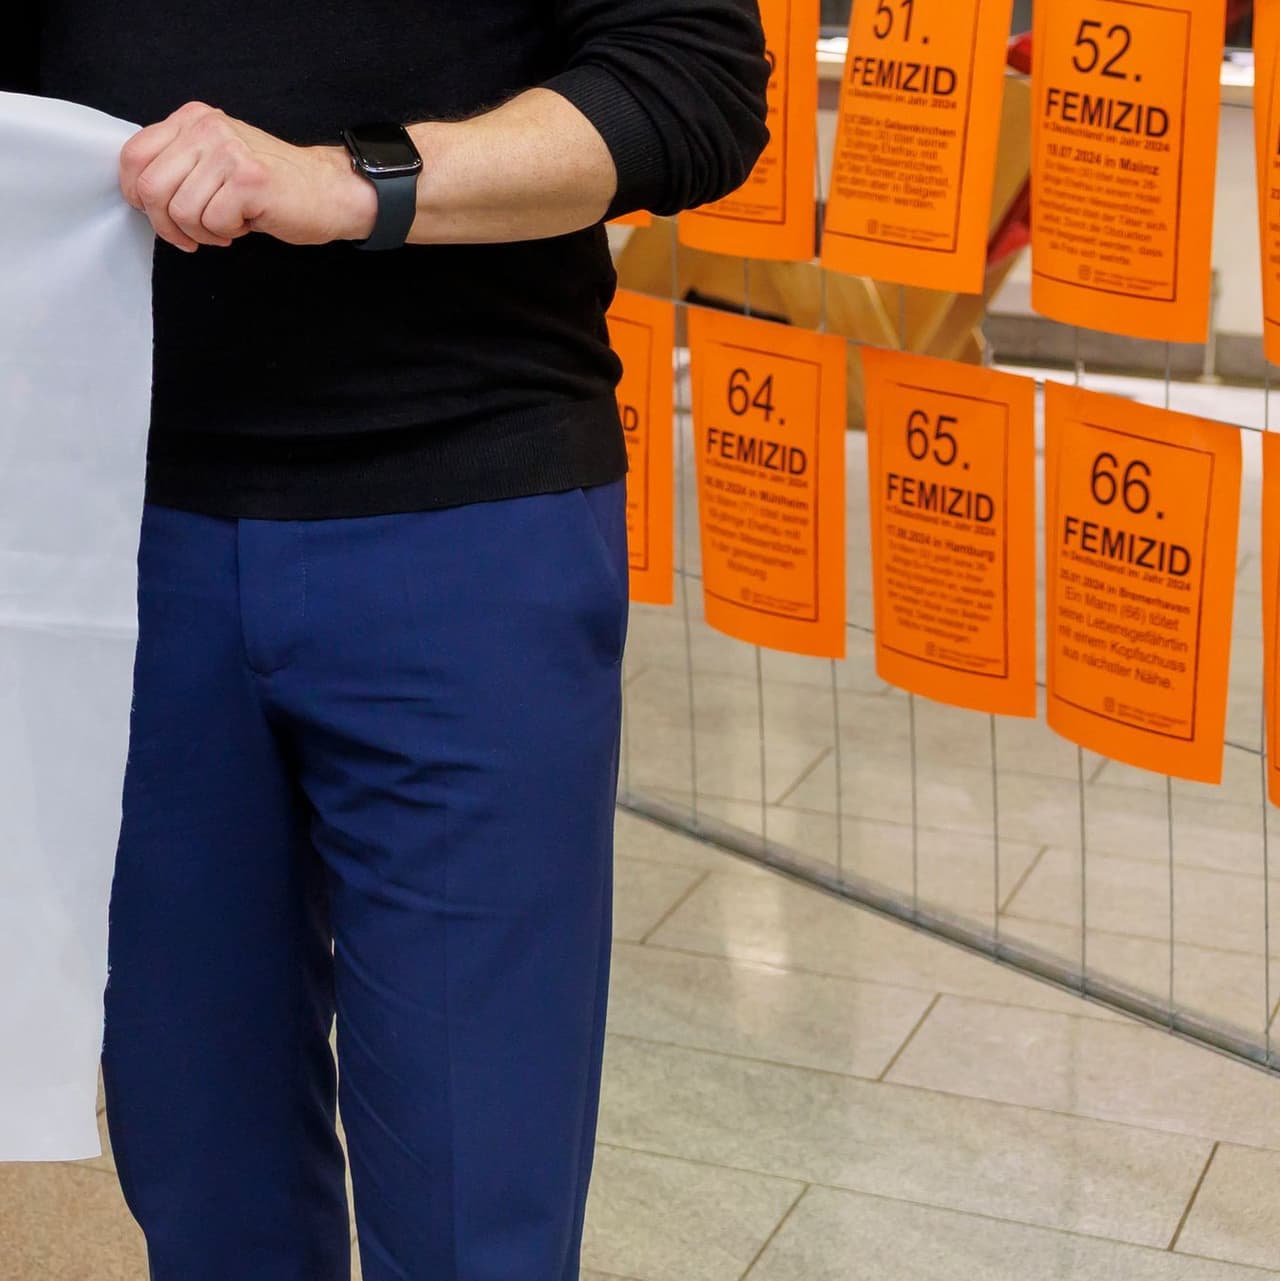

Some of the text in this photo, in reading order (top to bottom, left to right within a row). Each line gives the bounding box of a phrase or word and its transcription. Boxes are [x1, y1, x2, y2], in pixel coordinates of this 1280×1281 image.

[852, 55, 958, 97] FEMIZID
[1071, 18, 1142, 83] 52.
[931, 98, 957, 109] 2024
[1045, 87, 1170, 138] FEMIZID
[1119, 157, 1159, 175] Mainz
[1144, 138, 1170, 152] 2024
[727, 367, 786, 426] 64.
[707, 427, 807, 476] FEMIZID
[905, 409, 970, 471] 65.
[887, 472, 995, 525] FEMIZID
[1090, 451, 1165, 520] 66.
[1064, 515, 1192, 577] FEMIZID
